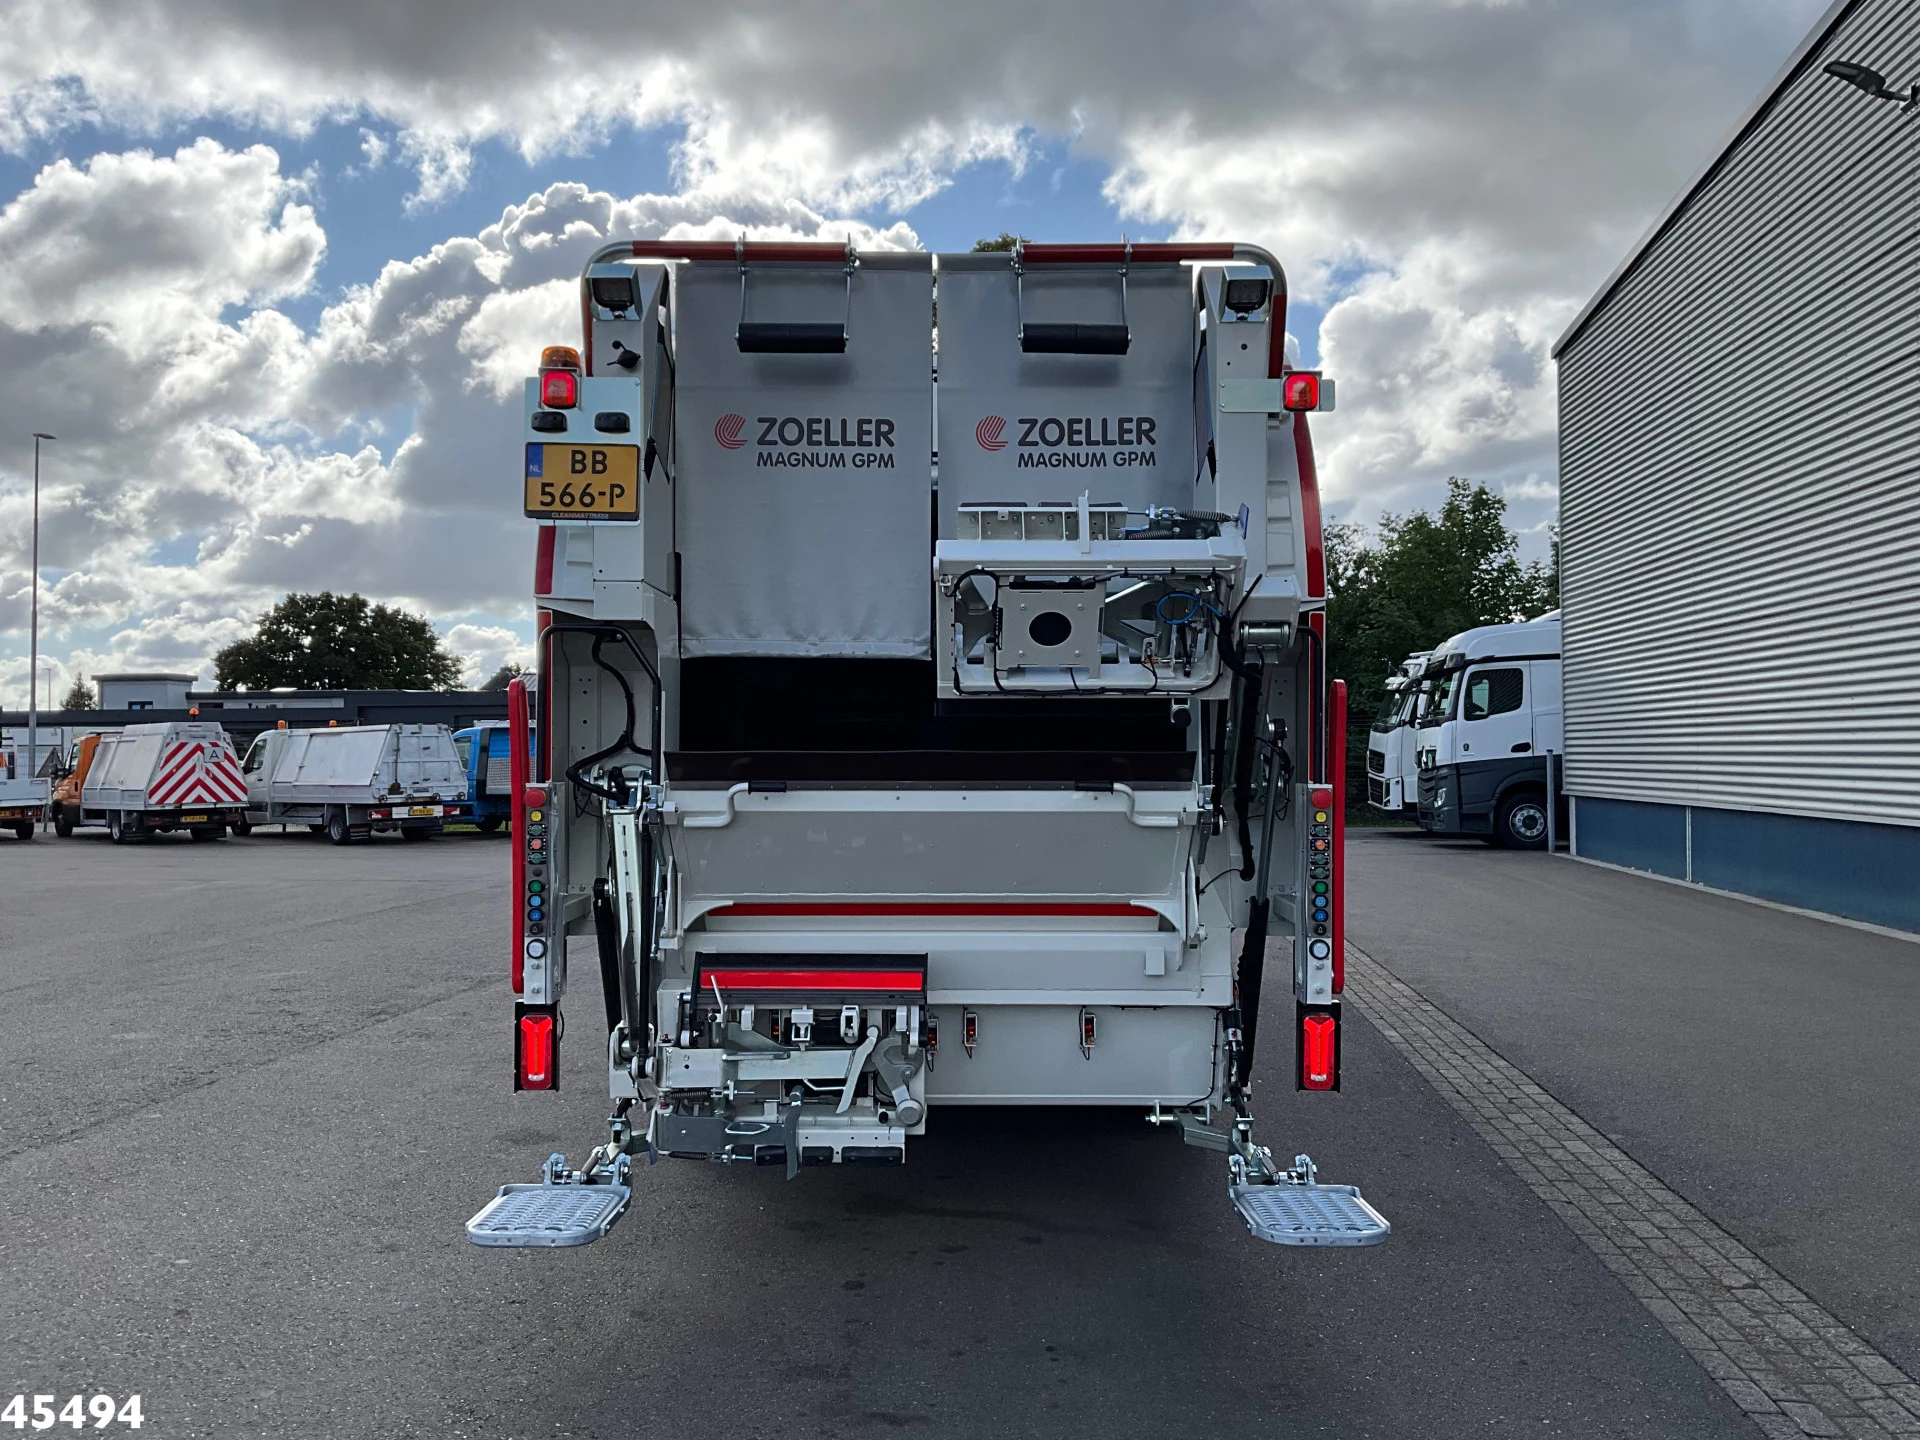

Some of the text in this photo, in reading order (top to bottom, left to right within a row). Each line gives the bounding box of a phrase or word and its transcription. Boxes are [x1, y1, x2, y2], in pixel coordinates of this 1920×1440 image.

[756, 417, 895, 447] ZOELLER
[1017, 417, 1157, 447] ZOELLER
[529, 464, 541, 473] NL
[570, 449, 608, 474] BB
[756, 452, 895, 468] MAGNUM GPM
[1017, 451, 1157, 468] MAGNUM GPM
[539, 482, 625, 508] 566-P
[209, 749, 220, 760] A
